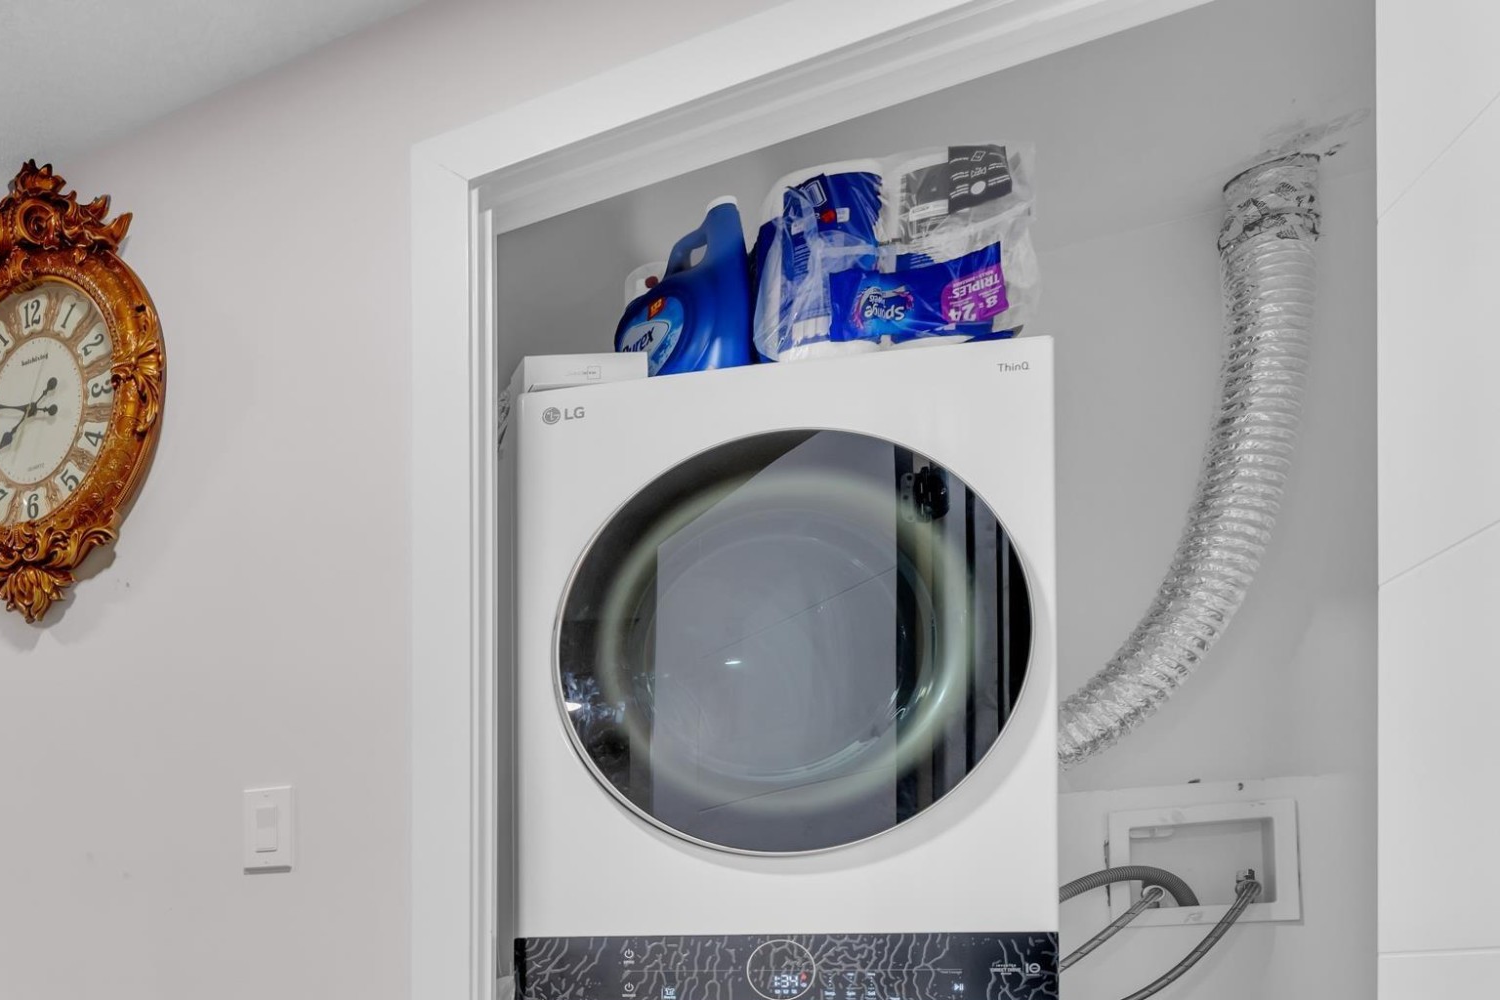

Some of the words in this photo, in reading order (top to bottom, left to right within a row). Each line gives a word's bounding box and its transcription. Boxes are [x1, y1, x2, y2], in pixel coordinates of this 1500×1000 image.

[952, 273, 1000, 299] TRIPLES
[23, 299, 41, 329] 12
[60, 302, 77, 329] 1
[948, 302, 977, 321] 24
[81, 333, 105, 356] 2
[996, 361, 1031, 372] ThinQ
[91, 378, 115, 398] 3
[564, 406, 585, 420] LG
[85, 430, 104, 446] 4
[60, 469, 80, 492] 5
[27, 493, 39, 519] 6
